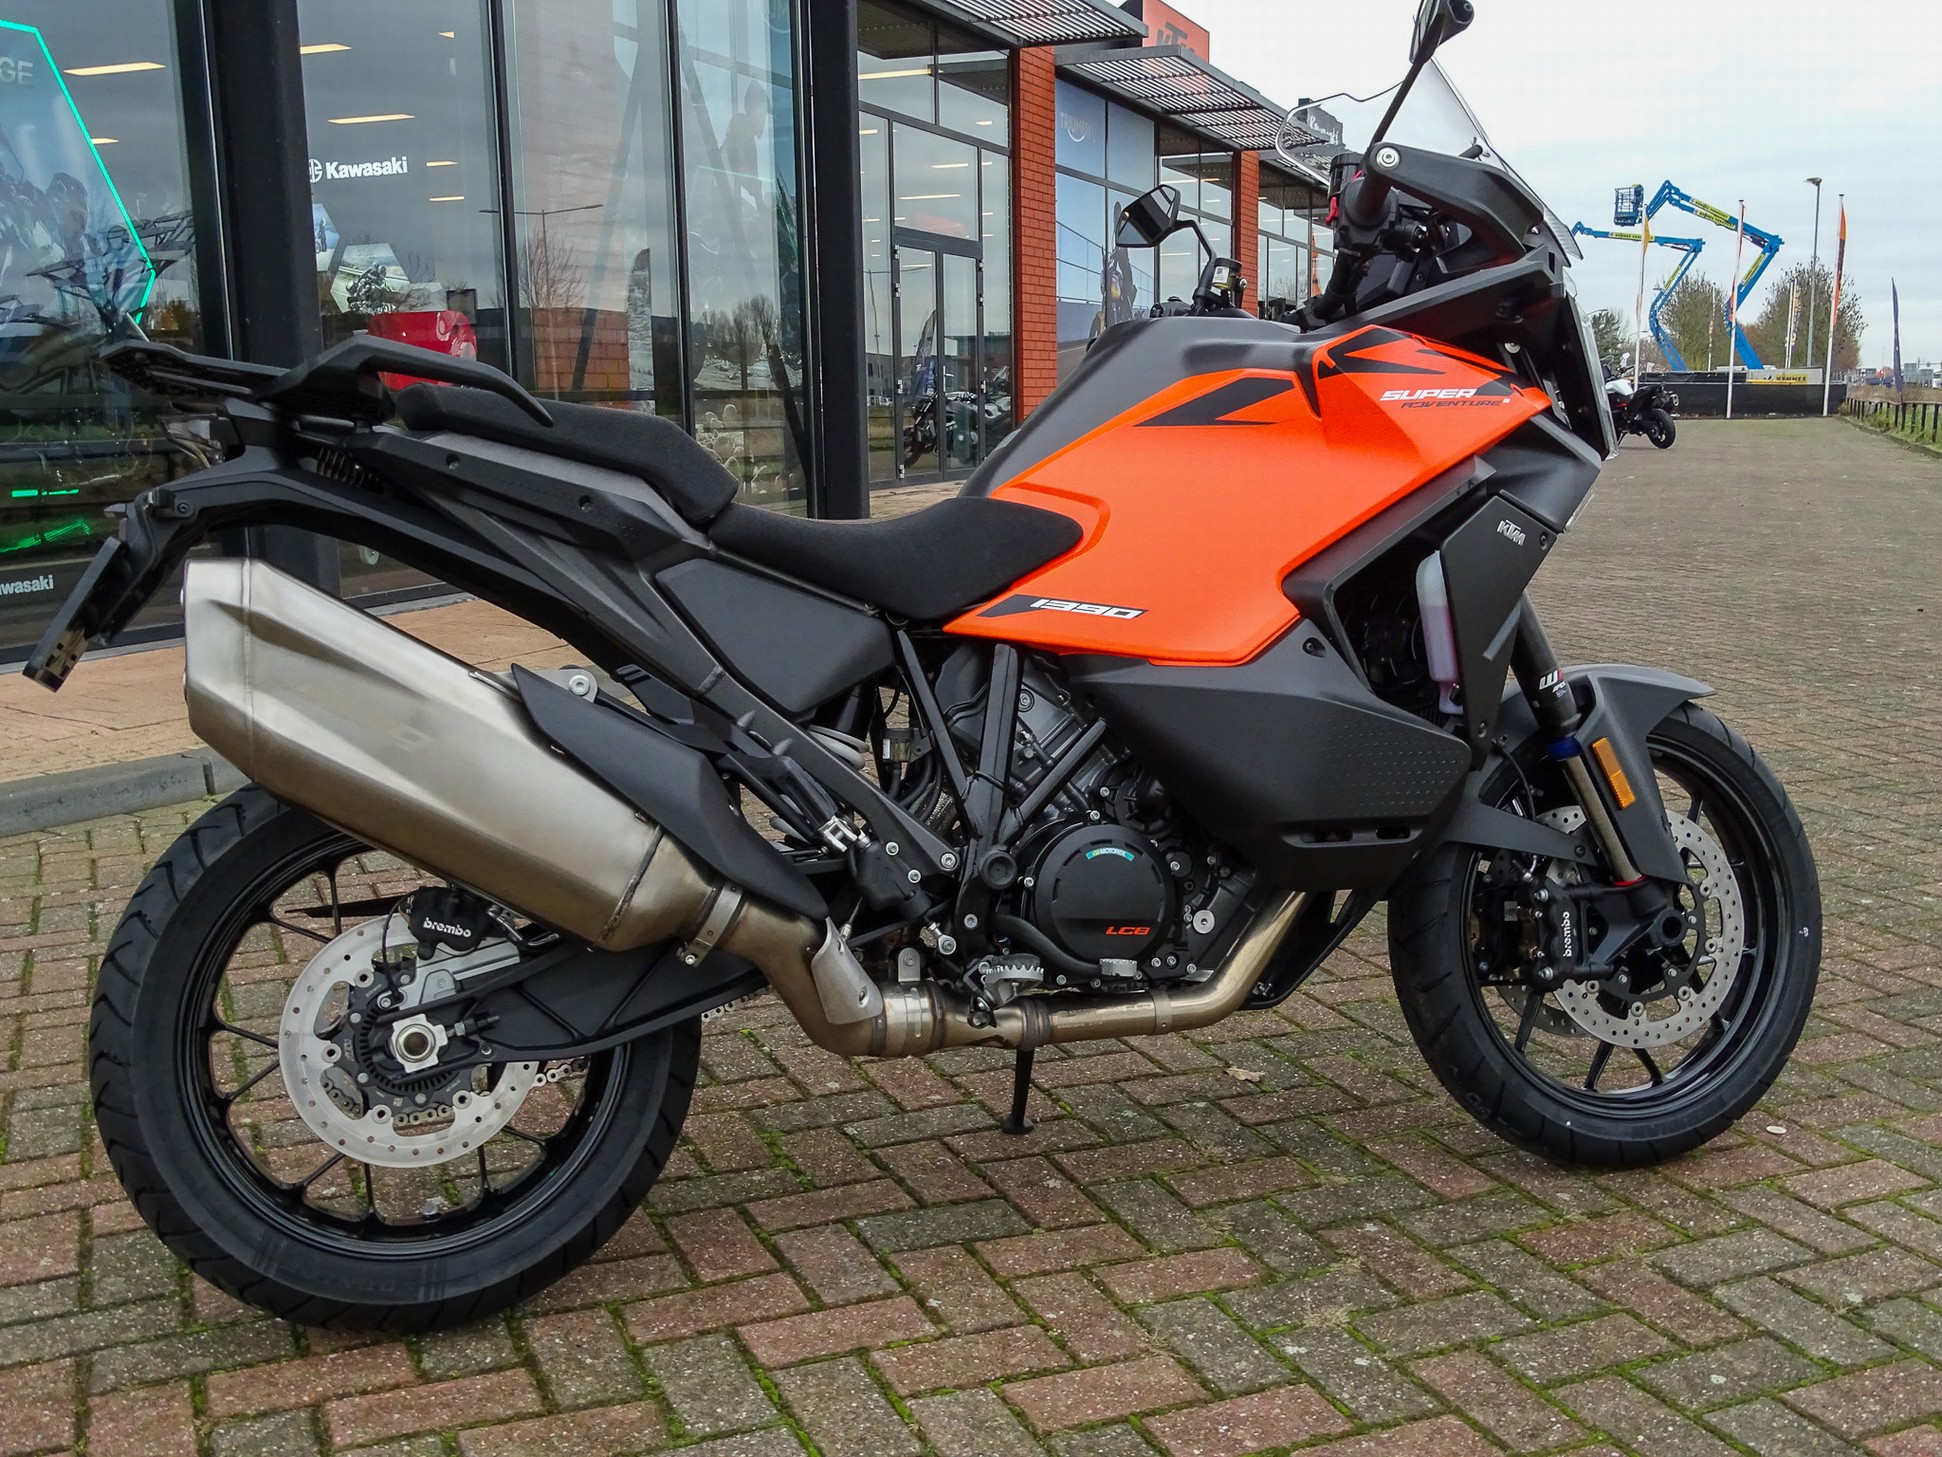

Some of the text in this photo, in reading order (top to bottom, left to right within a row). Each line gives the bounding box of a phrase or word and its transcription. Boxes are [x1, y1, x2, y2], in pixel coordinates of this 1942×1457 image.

[1156, 21, 1195, 52] KT
[325, 156, 408, 179] Kawasaki
[1380, 388, 1477, 401] SUPER
[1401, 400, 1502, 409] ADVENTURE
[1497, 519, 1526, 546] KTM
[0, 574, 54, 596] wasaki
[423, 917, 472, 938] brembo
[1105, 926, 1151, 935] LC8
[1561, 911, 1572, 957] brembo
